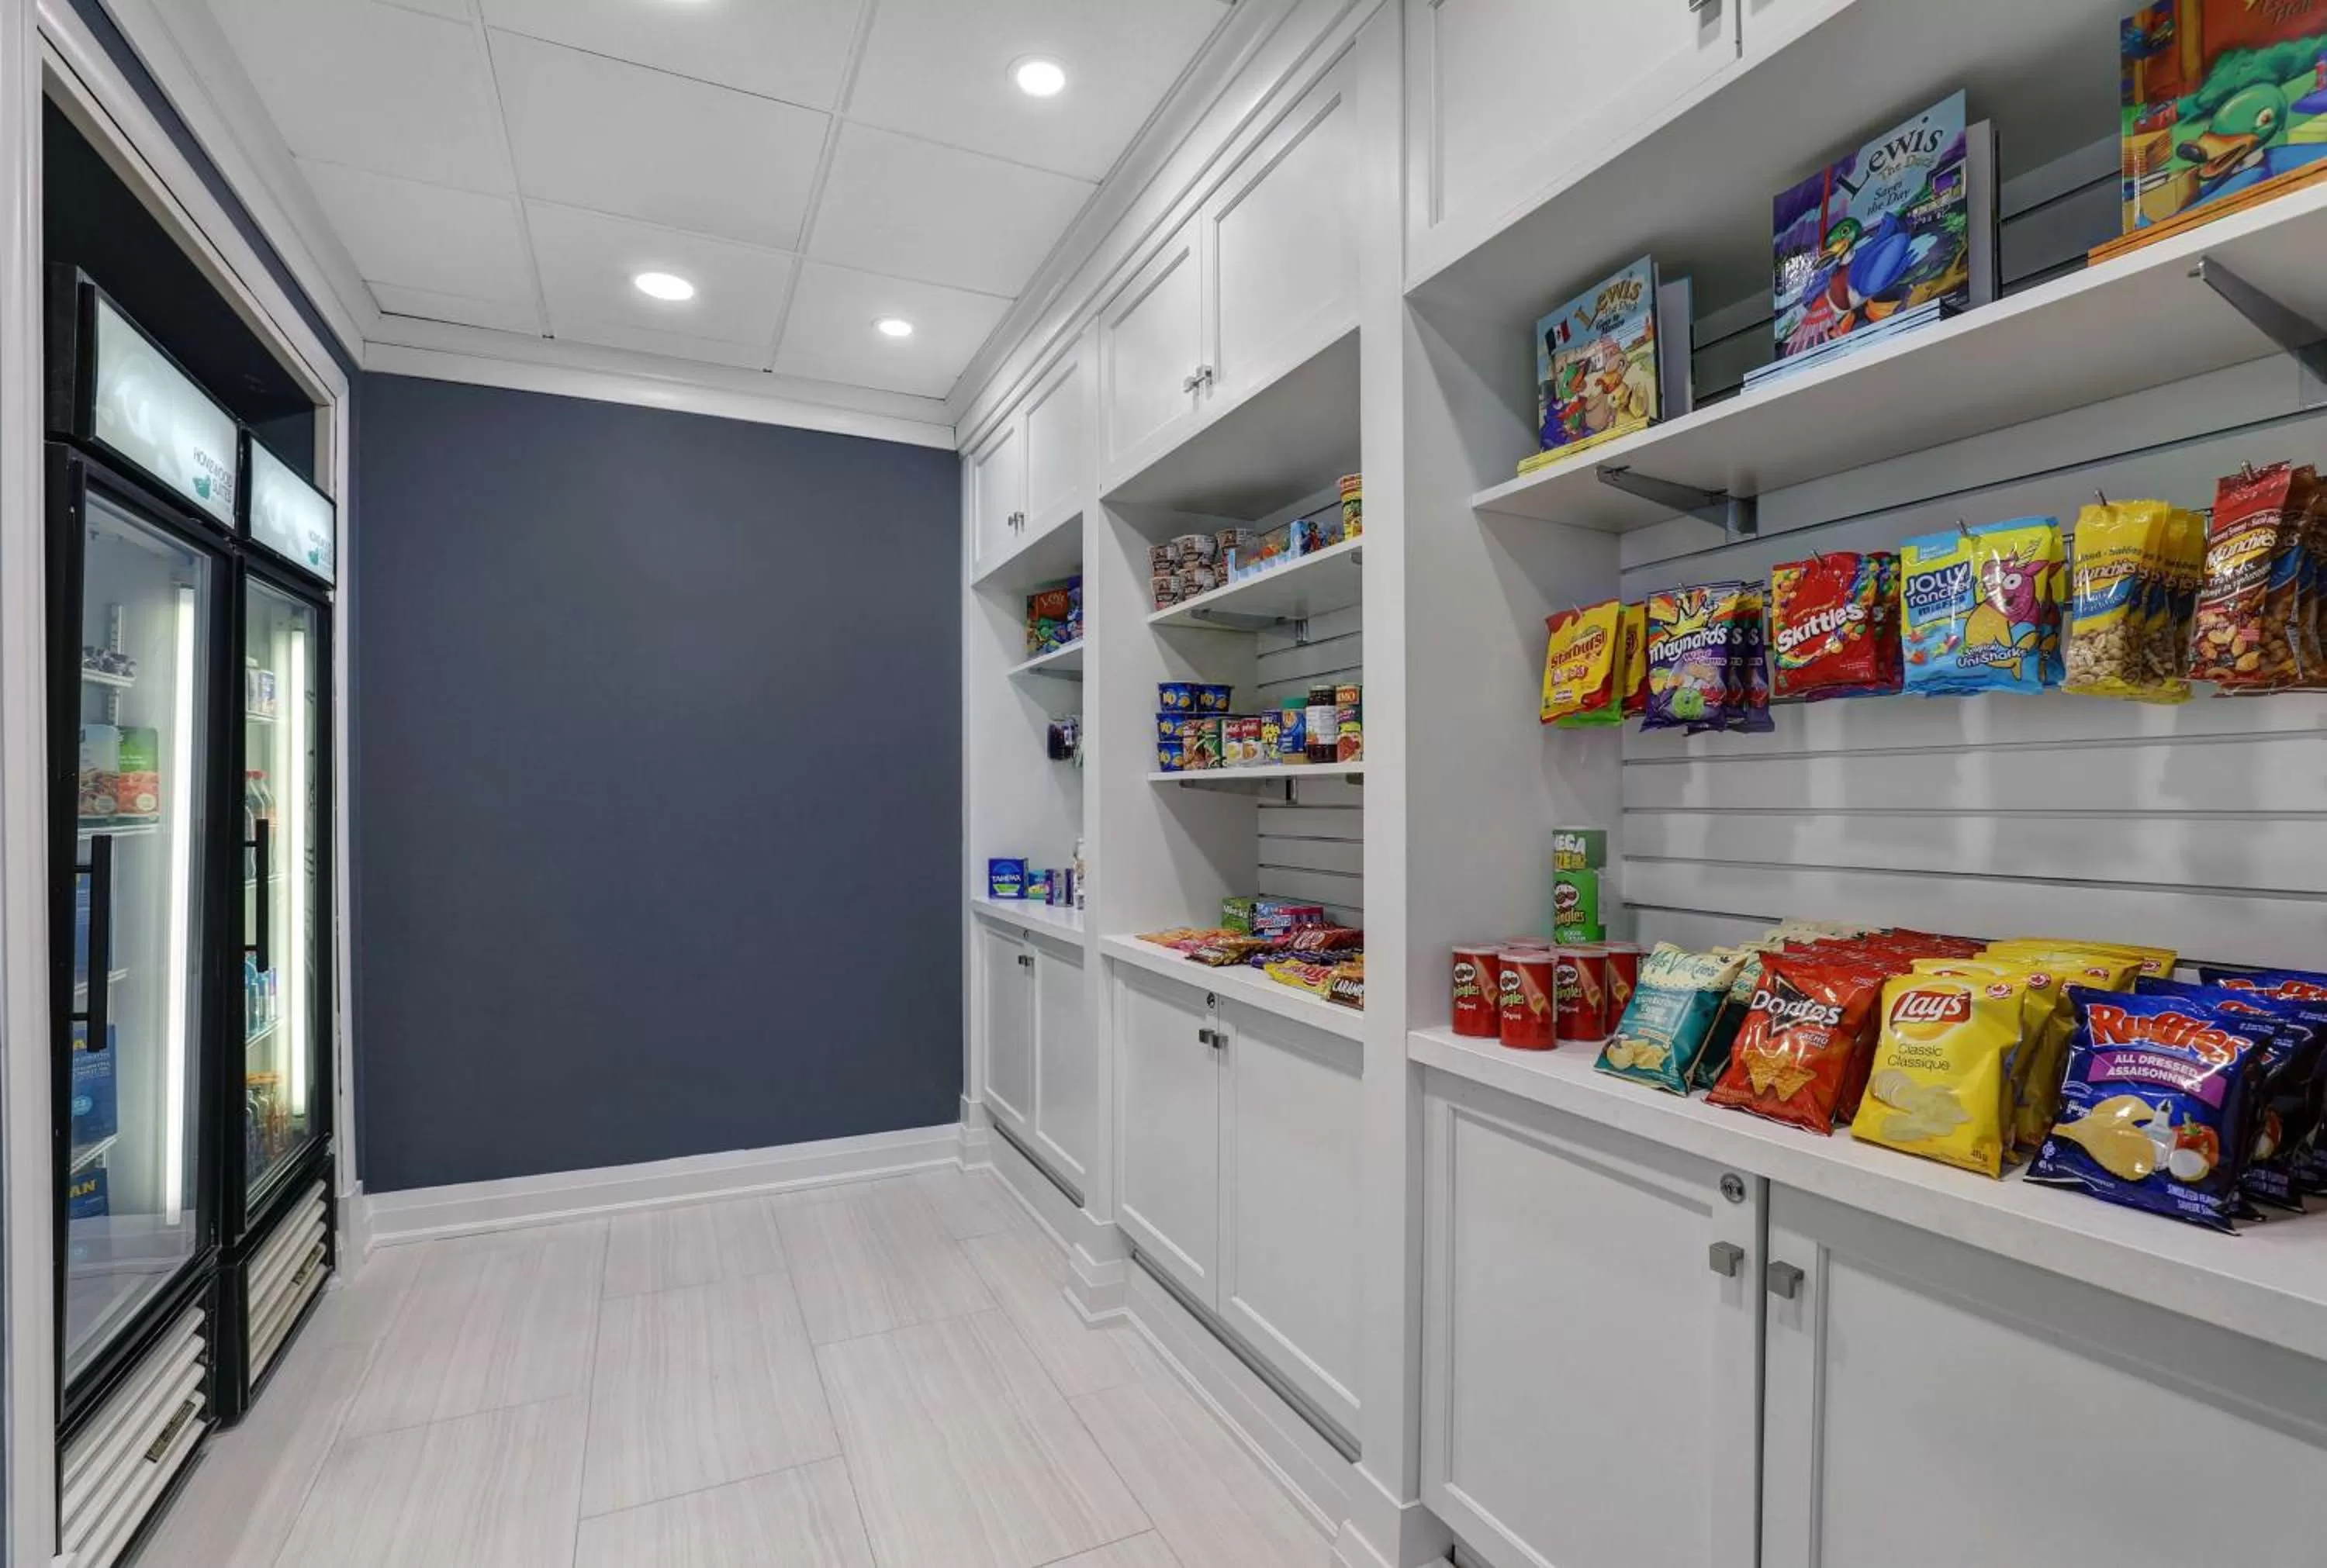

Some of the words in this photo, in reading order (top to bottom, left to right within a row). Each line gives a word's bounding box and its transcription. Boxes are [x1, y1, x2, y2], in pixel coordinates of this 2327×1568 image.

[1835, 115, 1944, 202] Lewis
[1574, 271, 1643, 333] Lewis
[1906, 562, 1970, 596] JOLLY
[1551, 627, 1609, 668] Starburst
[1648, 623, 1728, 665] Maynards
[1776, 603, 1865, 654] Skittles
[1332, 976, 1364, 996] CARAM
[1749, 989, 1844, 1025] Doritos
[1898, 1043, 1944, 1057] Classic
[2087, 1003, 2254, 1065] Ruffles
[1887, 1054, 1952, 1072] Classique
[2114, 1054, 2136, 1064] ALL
[2138, 1055, 2198, 1078] DRESSED
